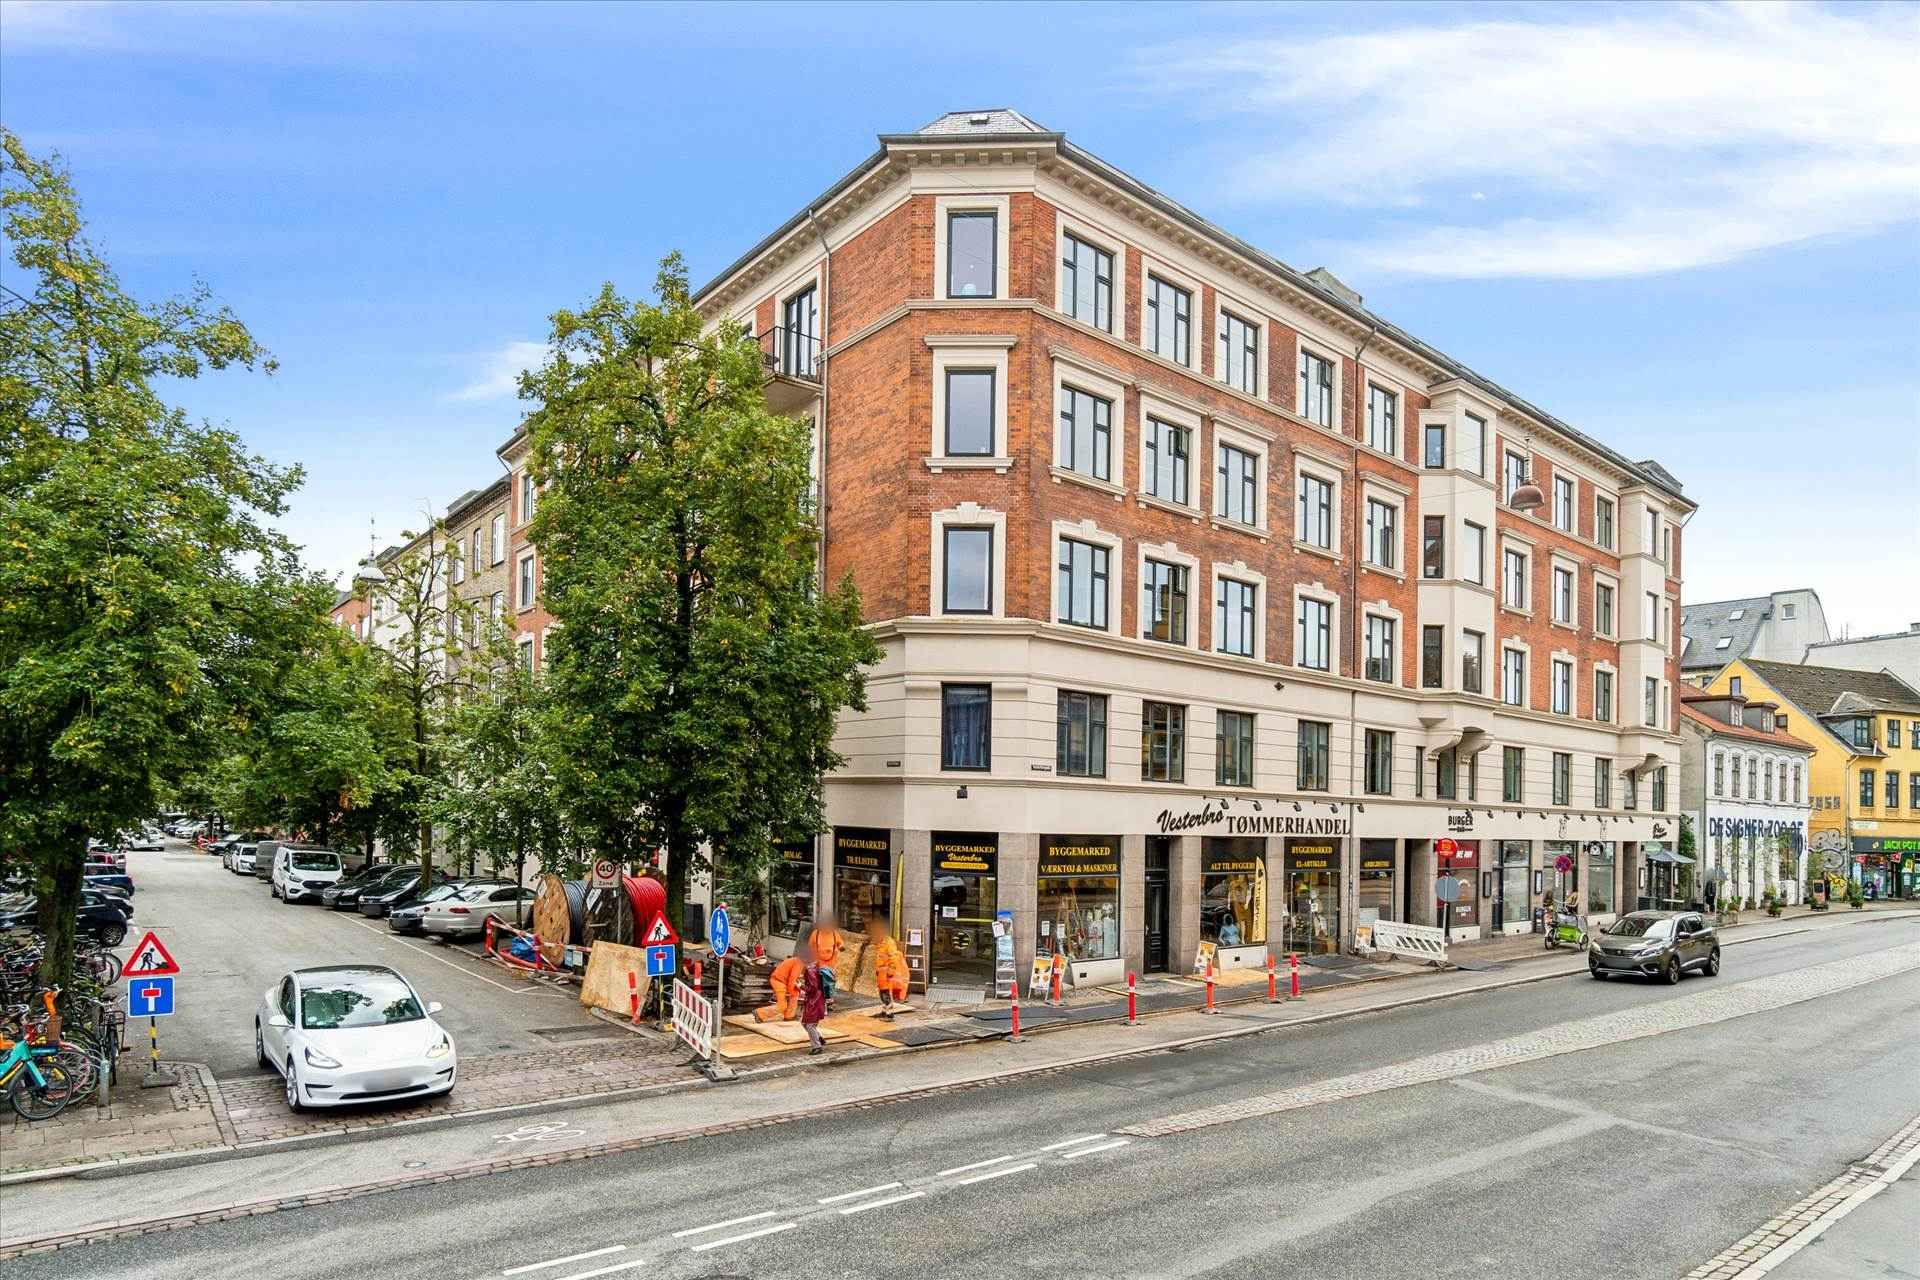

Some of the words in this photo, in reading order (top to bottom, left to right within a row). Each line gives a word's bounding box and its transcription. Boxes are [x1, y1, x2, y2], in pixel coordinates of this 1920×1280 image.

[1157, 803, 1224, 833] Vesterbro
[1448, 815, 1474, 826] BURGER
[1226, 816, 1350, 835] TØMMERHANDEL
[839, 838, 887, 850] BYGGEMARKED
[935, 844, 995, 853] BYGGEMARKED
[1049, 847, 1110, 856] BYGGEMARKED
[600, 864, 613, 873] 40
[1083, 864, 1117, 873] MASKINER
